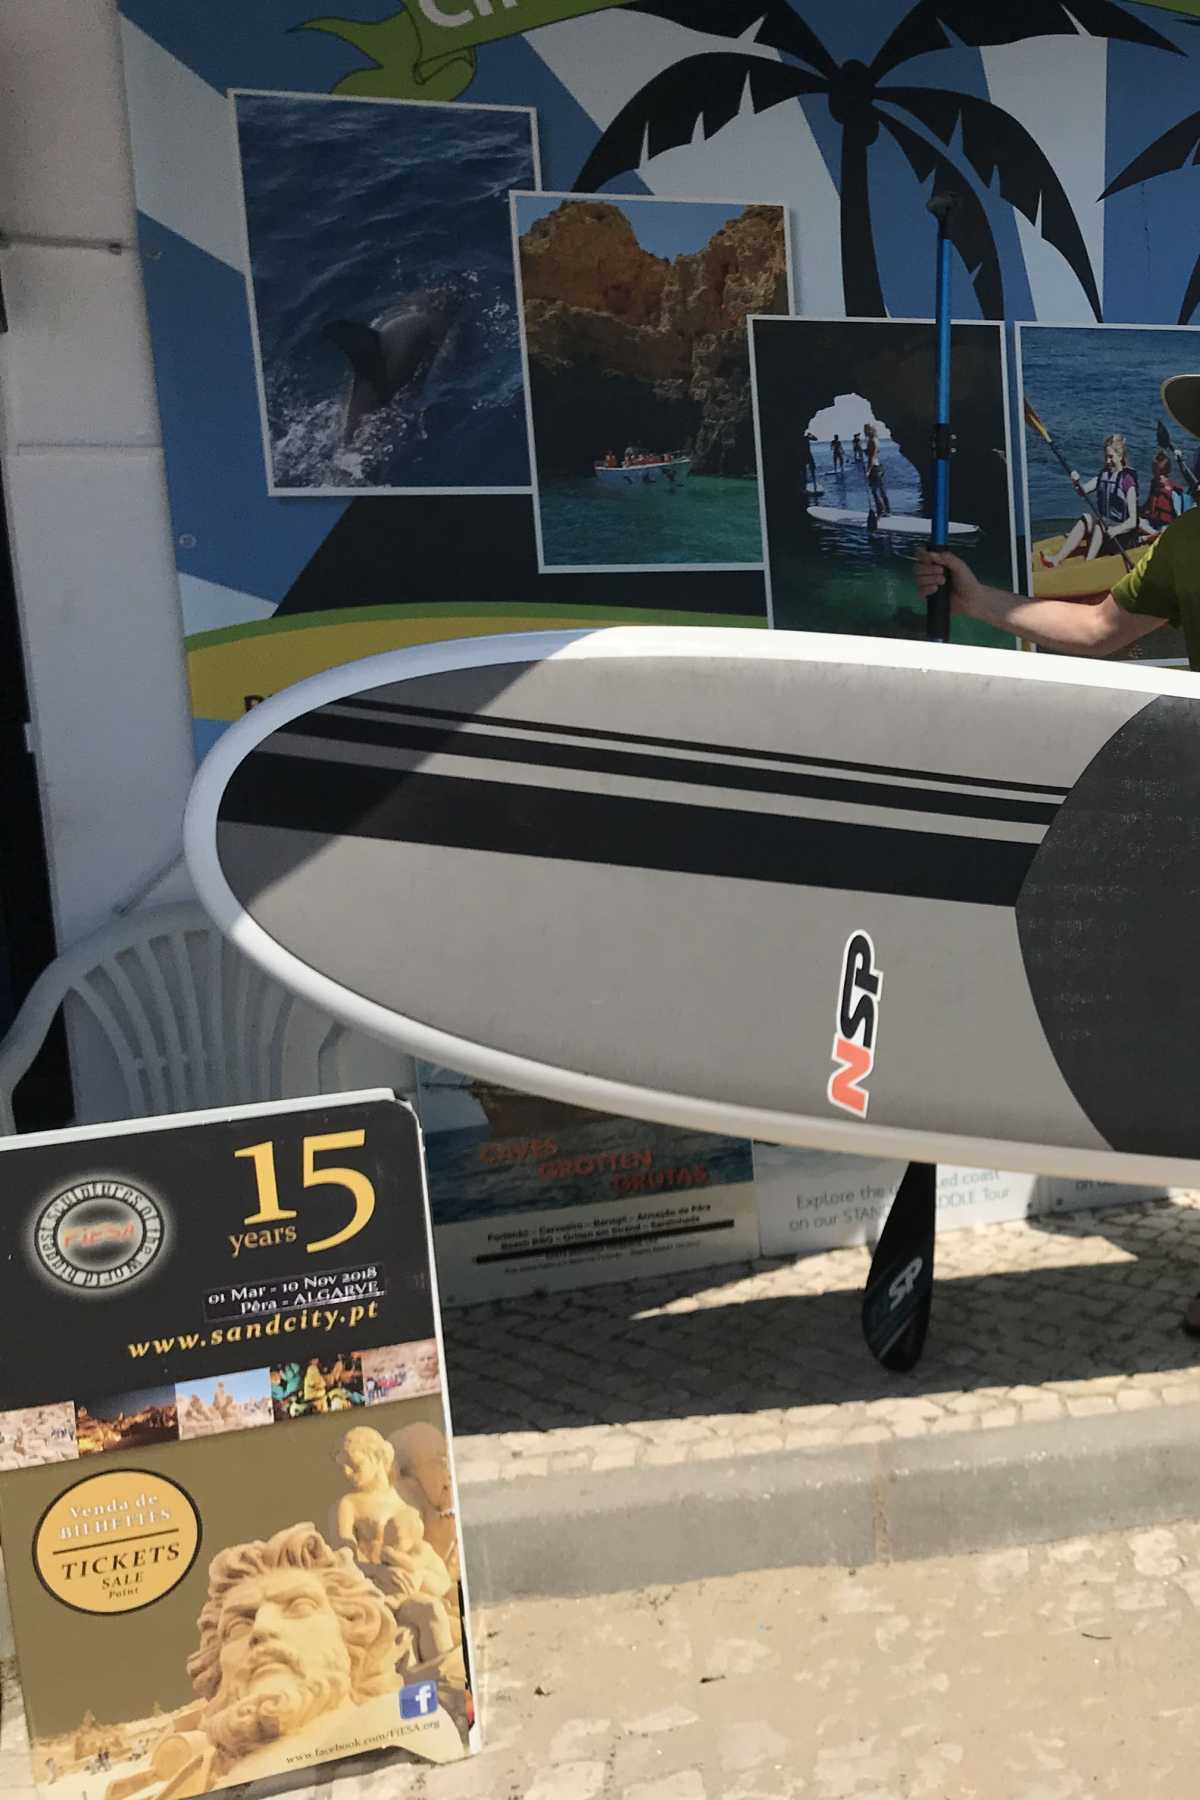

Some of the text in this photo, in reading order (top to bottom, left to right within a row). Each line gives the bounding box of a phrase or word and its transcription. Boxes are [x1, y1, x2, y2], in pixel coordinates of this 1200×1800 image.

[827, 929, 884, 1119] NSP
[234, 1128, 377, 1254] 15
[796, 1188, 856, 1212] Explore
[228, 1222, 298, 1257] years
[789, 1218, 809, 1233] on
[208, 1293, 225, 1305] 01
[231, 1286, 267, 1301] Mar
[282, 1281, 299, 1293] 10
[304, 1275, 338, 1290] Nov
[342, 1266, 378, 1282] 2018
[294, 1280, 379, 1306] ALGARVE
[128, 1299, 379, 1359] www.sandcity.pt
[70, 1492, 159, 1518] Venda de
[62, 1542, 181, 1581] TICKETS
[101, 1572, 145, 1590] SALE
